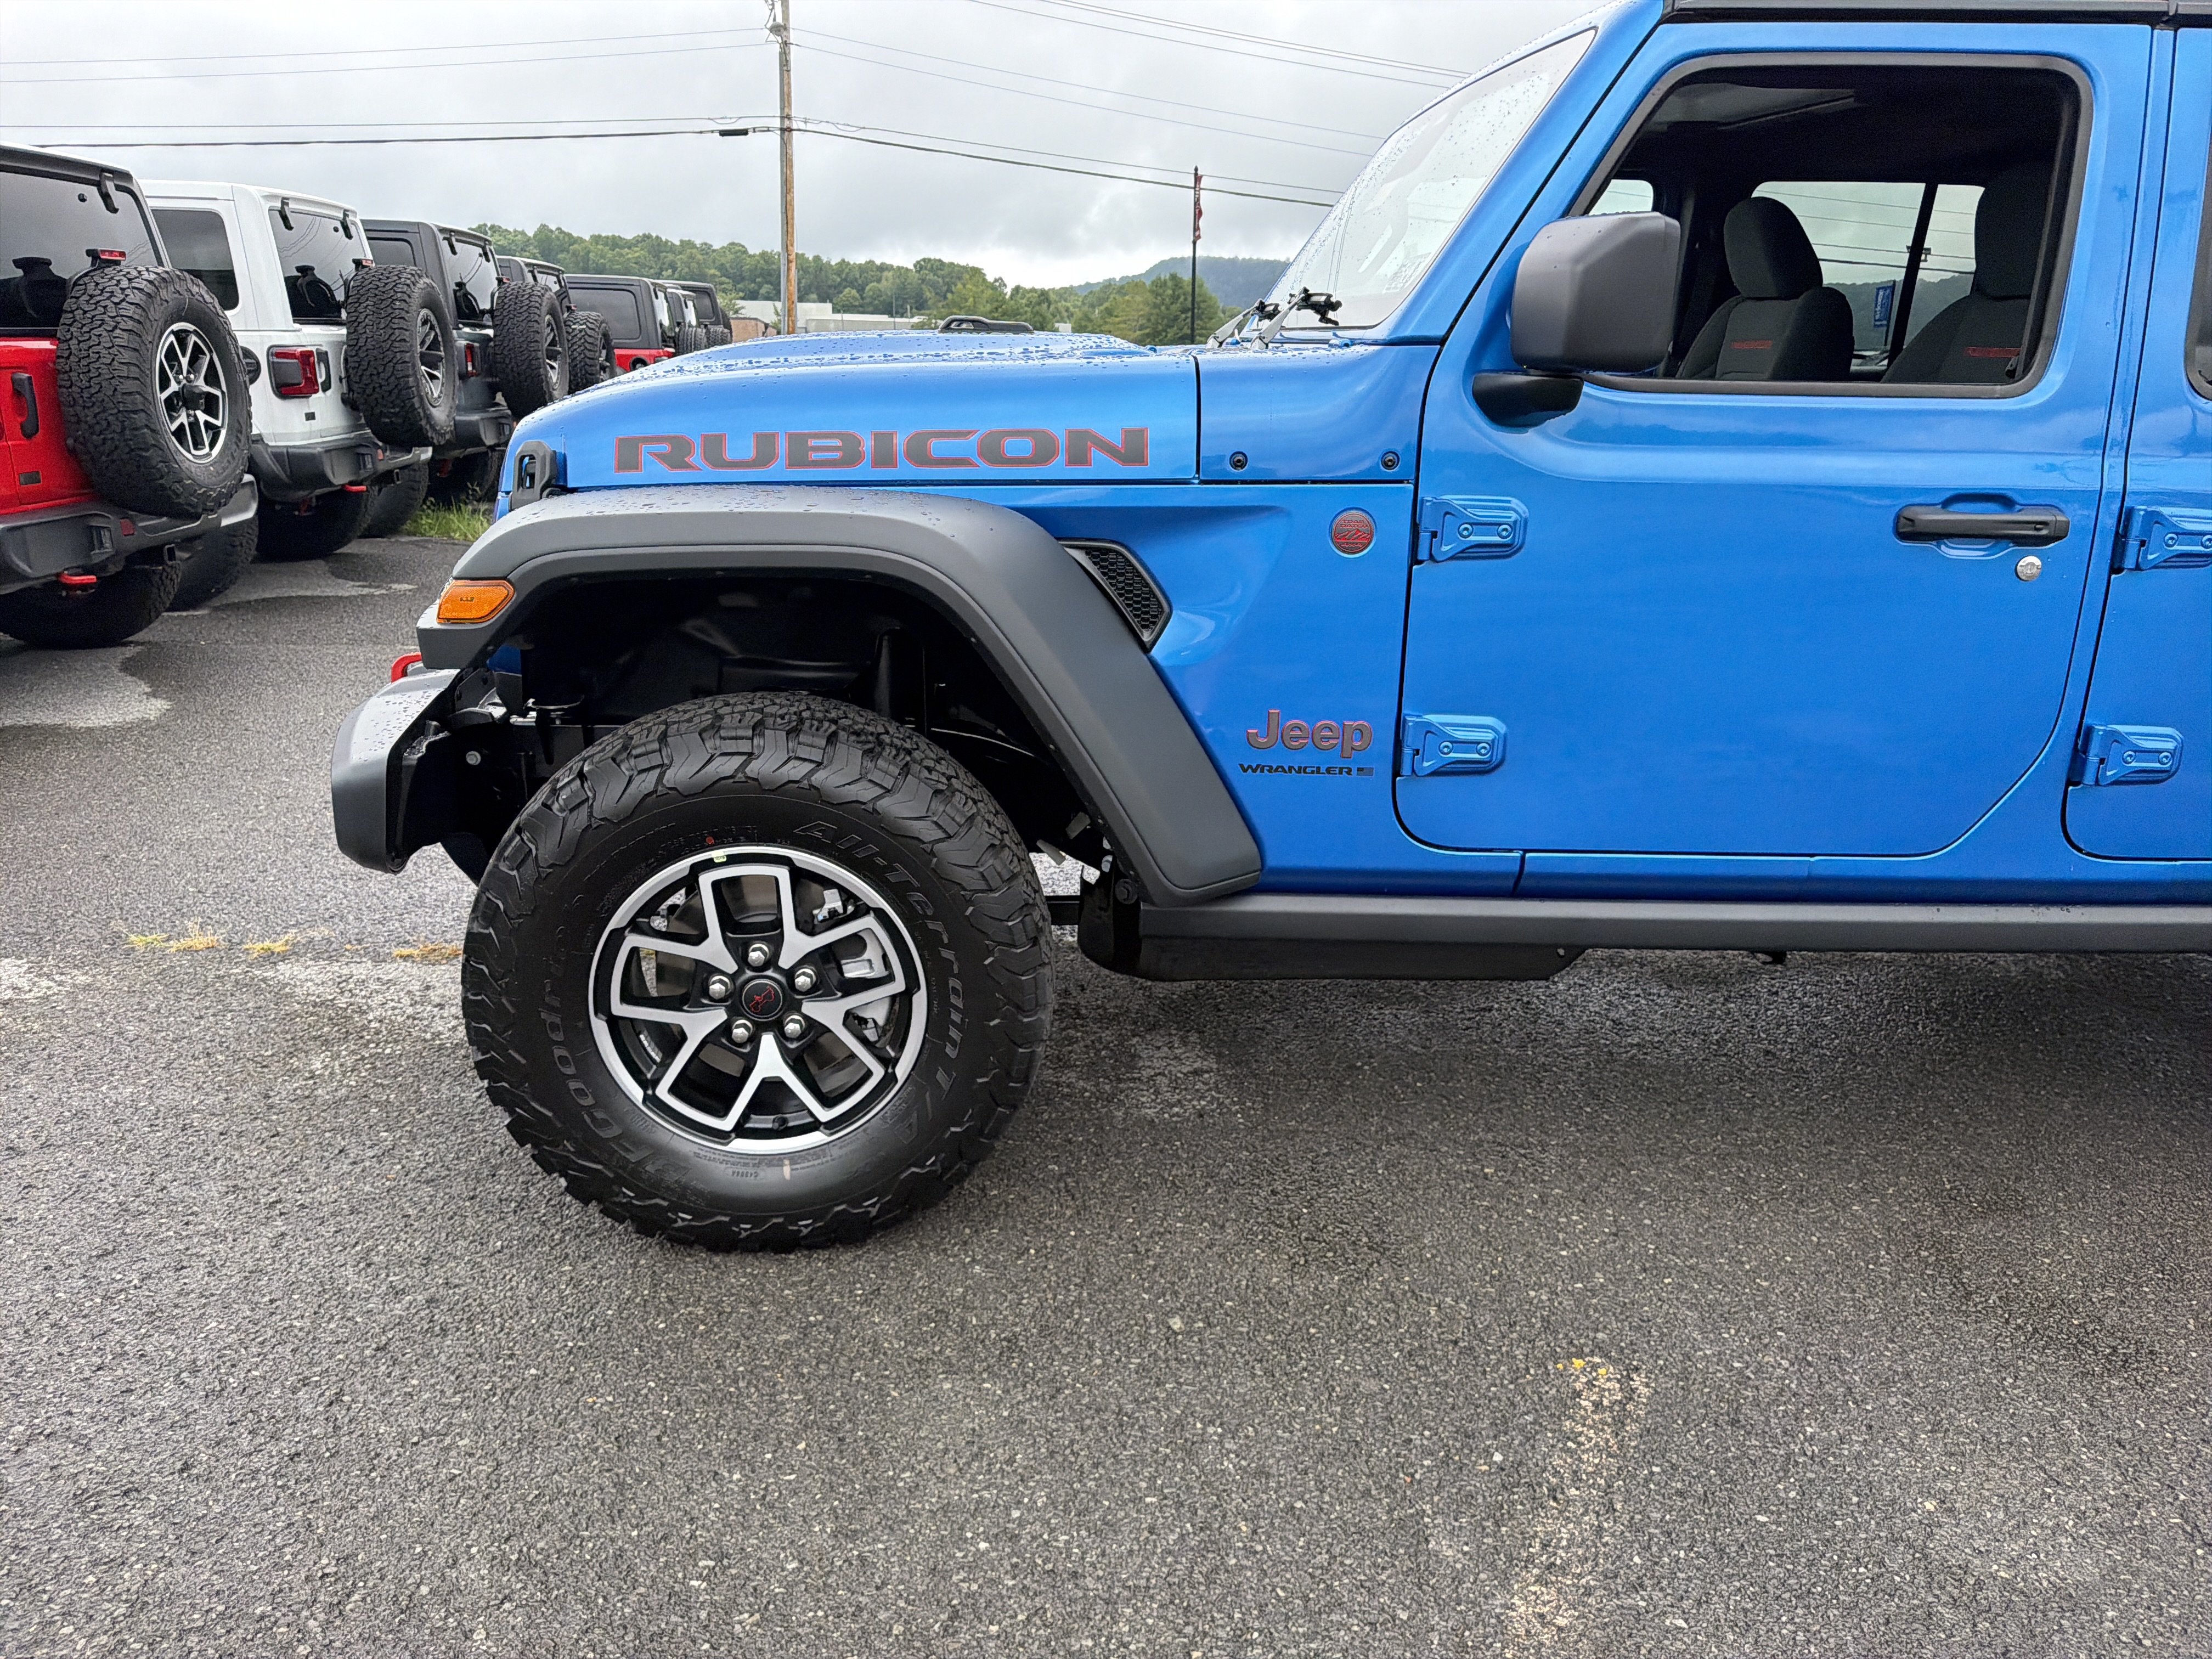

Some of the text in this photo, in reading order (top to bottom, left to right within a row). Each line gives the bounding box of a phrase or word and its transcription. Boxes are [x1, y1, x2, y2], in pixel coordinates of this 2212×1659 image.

[614, 427, 1150, 473] RUBICON
[1246, 709, 1373, 759] Jeep
[1238, 763, 1352, 776] WRANGLER
[793, 820, 970, 1059] All-Terrain
